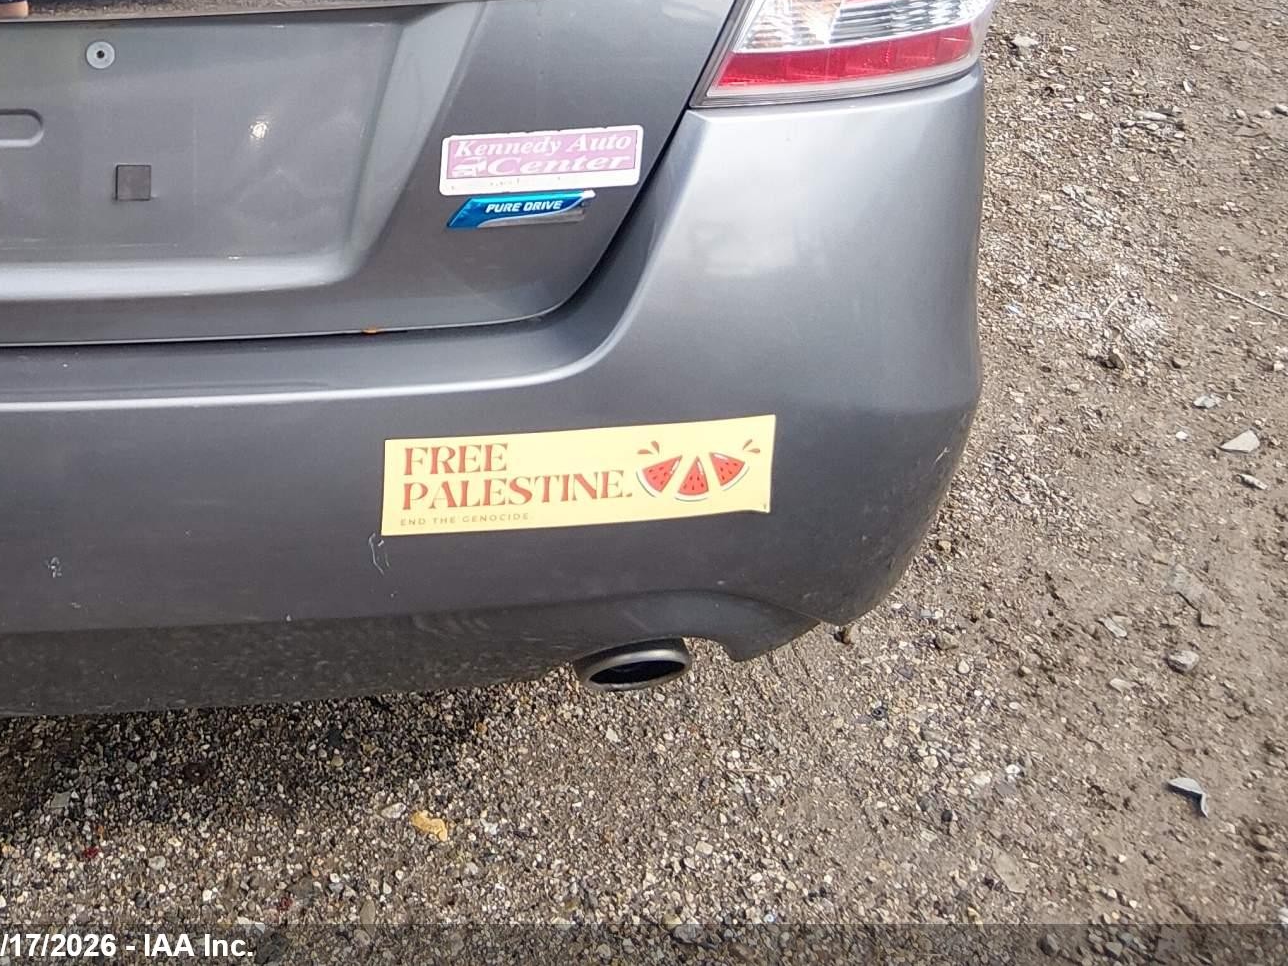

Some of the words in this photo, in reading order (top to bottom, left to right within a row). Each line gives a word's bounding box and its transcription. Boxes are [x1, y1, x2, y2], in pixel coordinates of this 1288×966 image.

[455, 135, 562, 160] Kennedy
[565, 133, 632, 153] Auto
[488, 155, 631, 176] Center
[485, 201, 523, 214] PURE
[523, 199, 564, 212] DRIVE
[403, 442, 509, 476] FREE
[402, 469, 633, 511] PALESTINE.
[400, 517, 427, 526] END
[433, 516, 456, 525] THE
